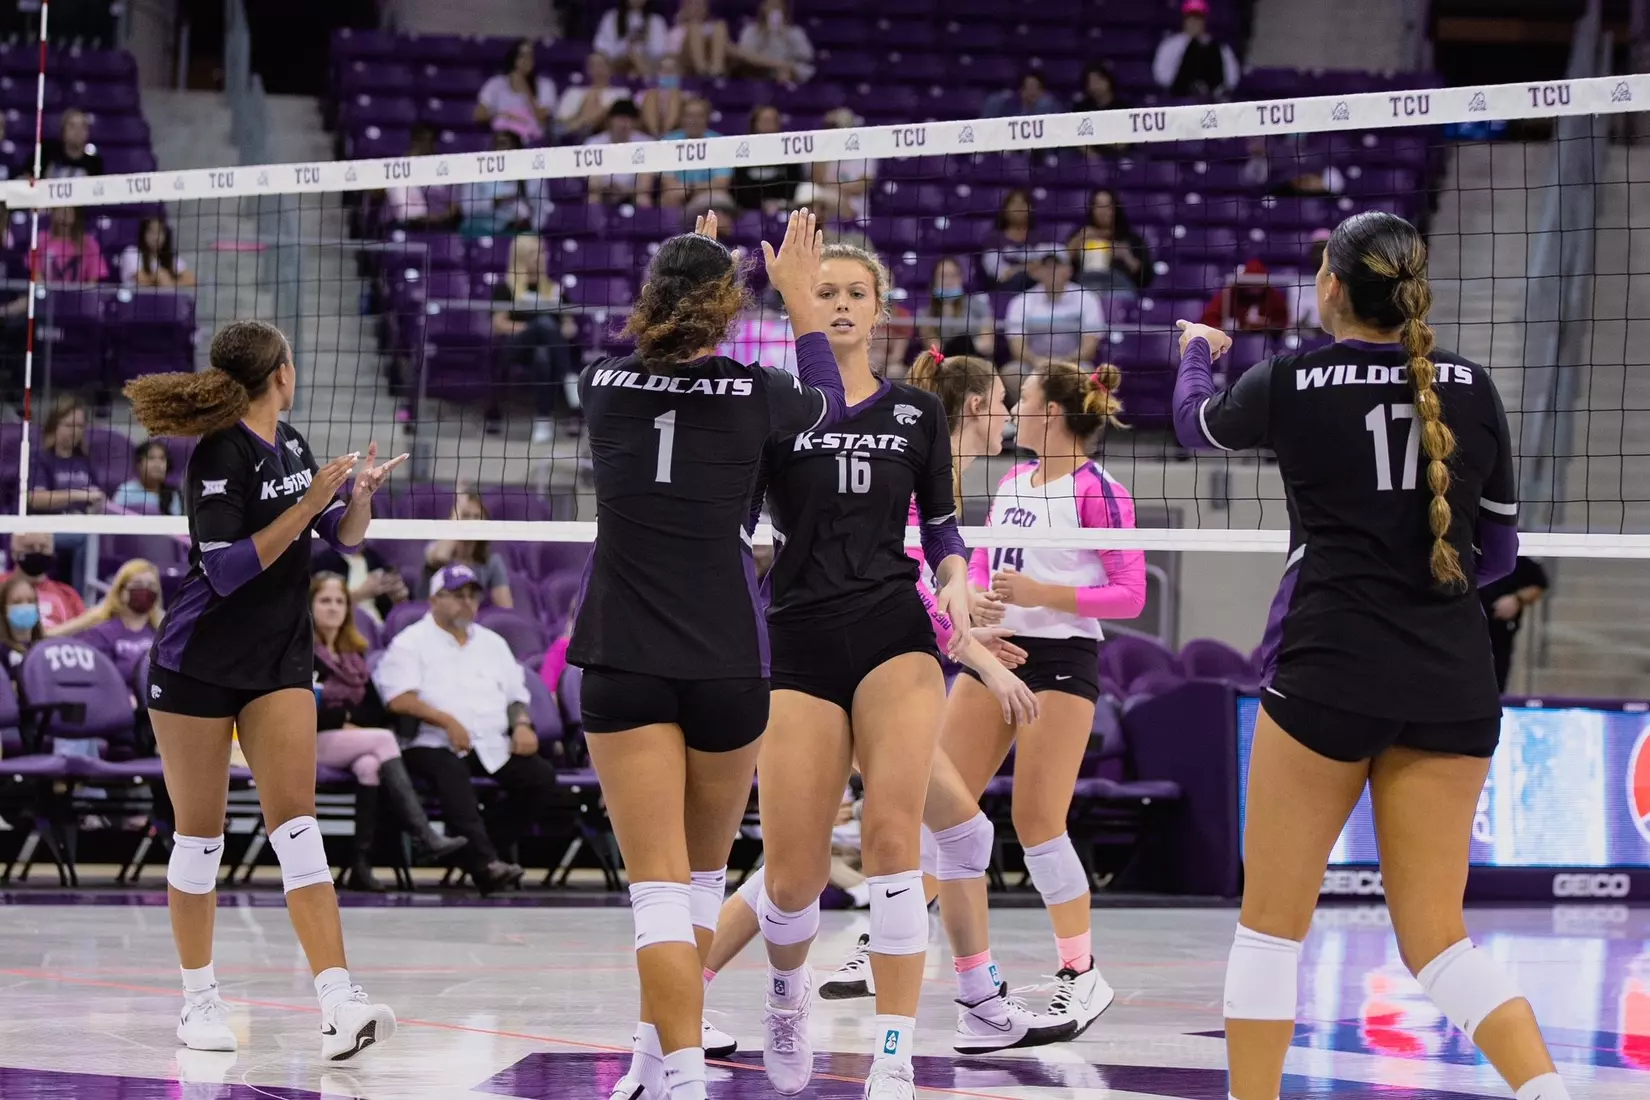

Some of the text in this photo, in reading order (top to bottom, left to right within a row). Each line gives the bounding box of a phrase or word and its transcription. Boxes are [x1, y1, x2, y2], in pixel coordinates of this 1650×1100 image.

[48, 84, 1571, 199] TCU TCU TCU TCU TCU TCU TCU TCU TCU TCU TCU TCU TCU TCU TCU
[591, 369, 753, 396] WILDCATS
[1296, 363, 1473, 390] WILDCTS
[653, 409, 677, 483] 1
[793, 431, 908, 452] K-STATE
[1365, 403, 1422, 490] 17
[260, 468, 313, 500] K-STAT
[835, 450, 872, 494] 16
[1001, 507, 1037, 528] TCU
[44, 643, 96, 672] TCU
[1553, 873, 1631, 897] GEICO
